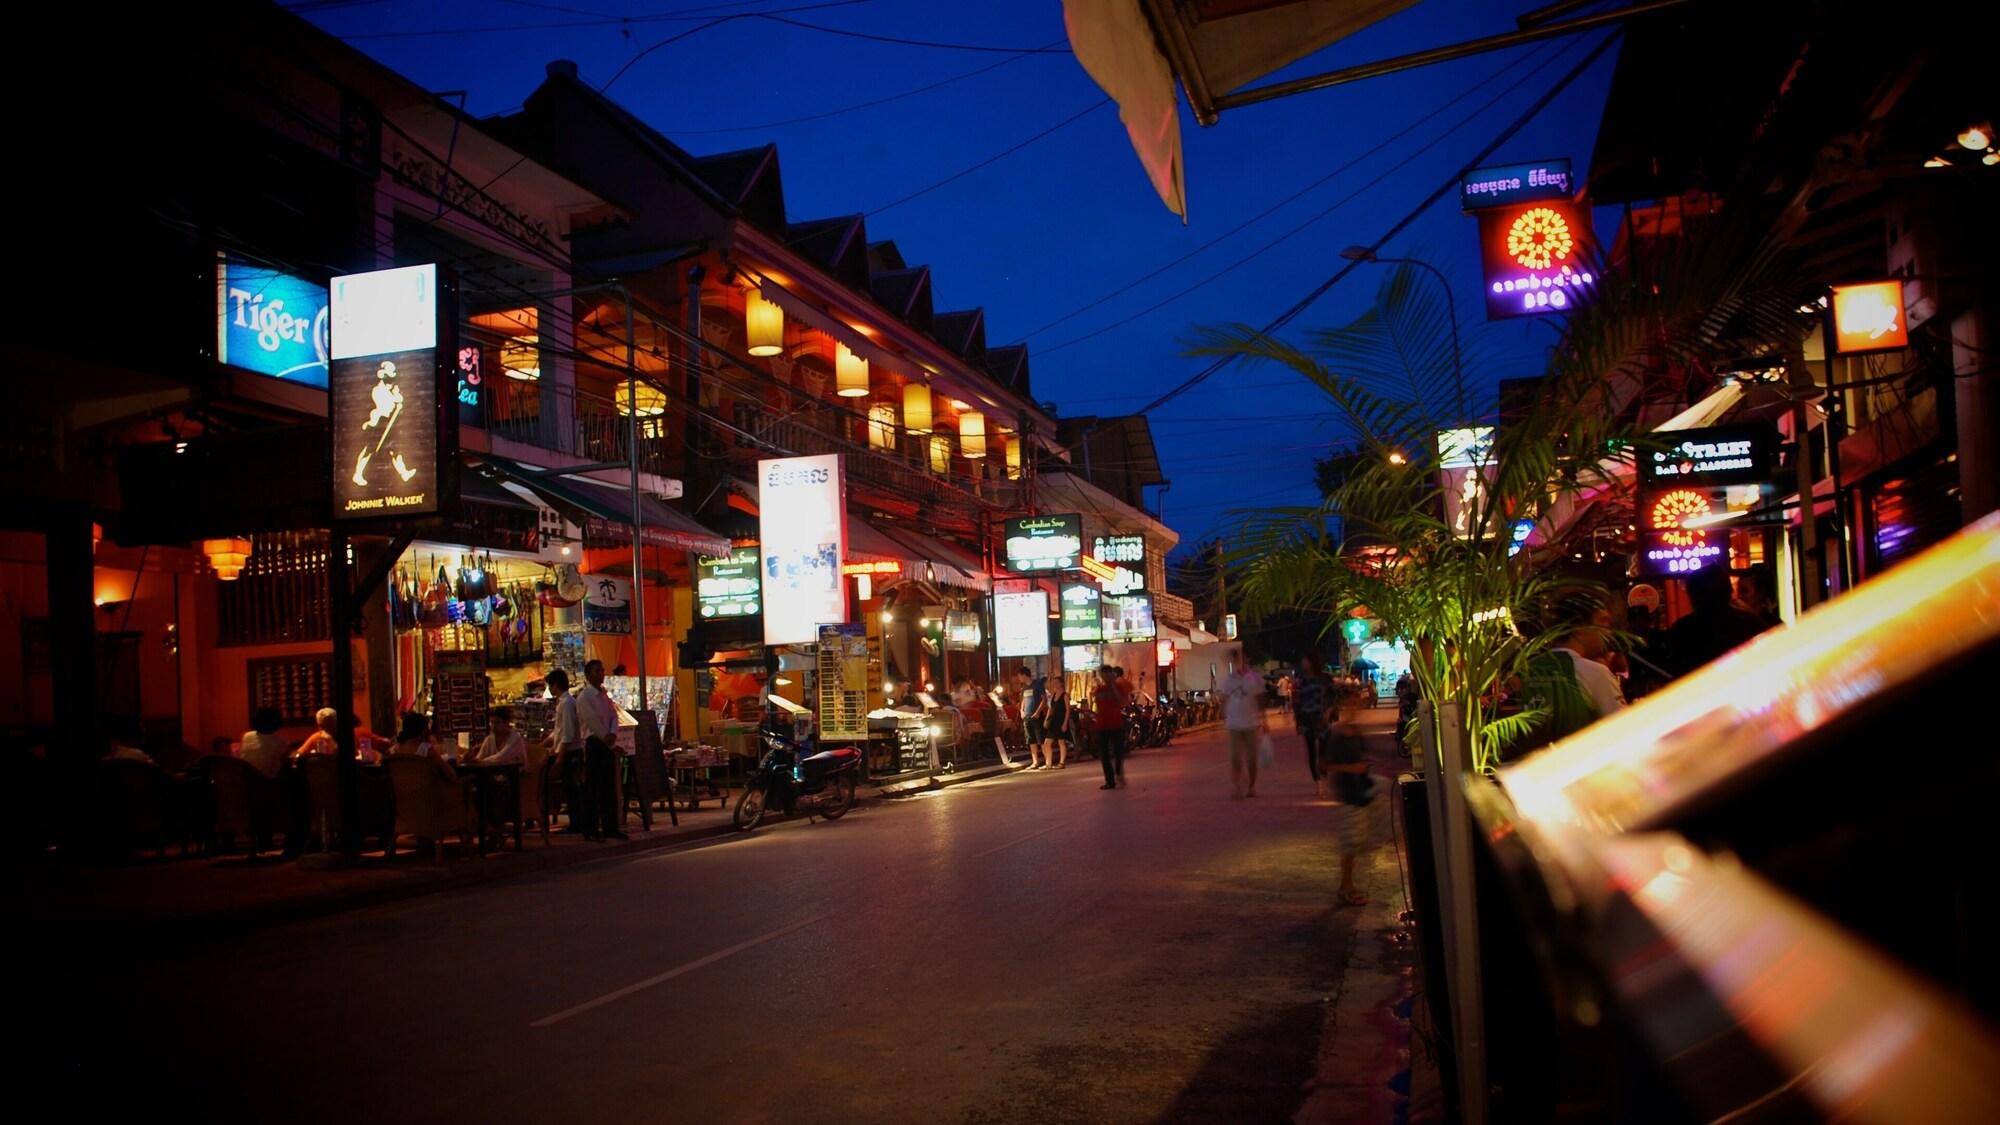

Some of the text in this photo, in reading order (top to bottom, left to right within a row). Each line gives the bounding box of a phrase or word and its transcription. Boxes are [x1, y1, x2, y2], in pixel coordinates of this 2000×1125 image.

[230, 287, 309, 352] Tiger
[345, 493, 425, 512] JOHNNIE WALKER
